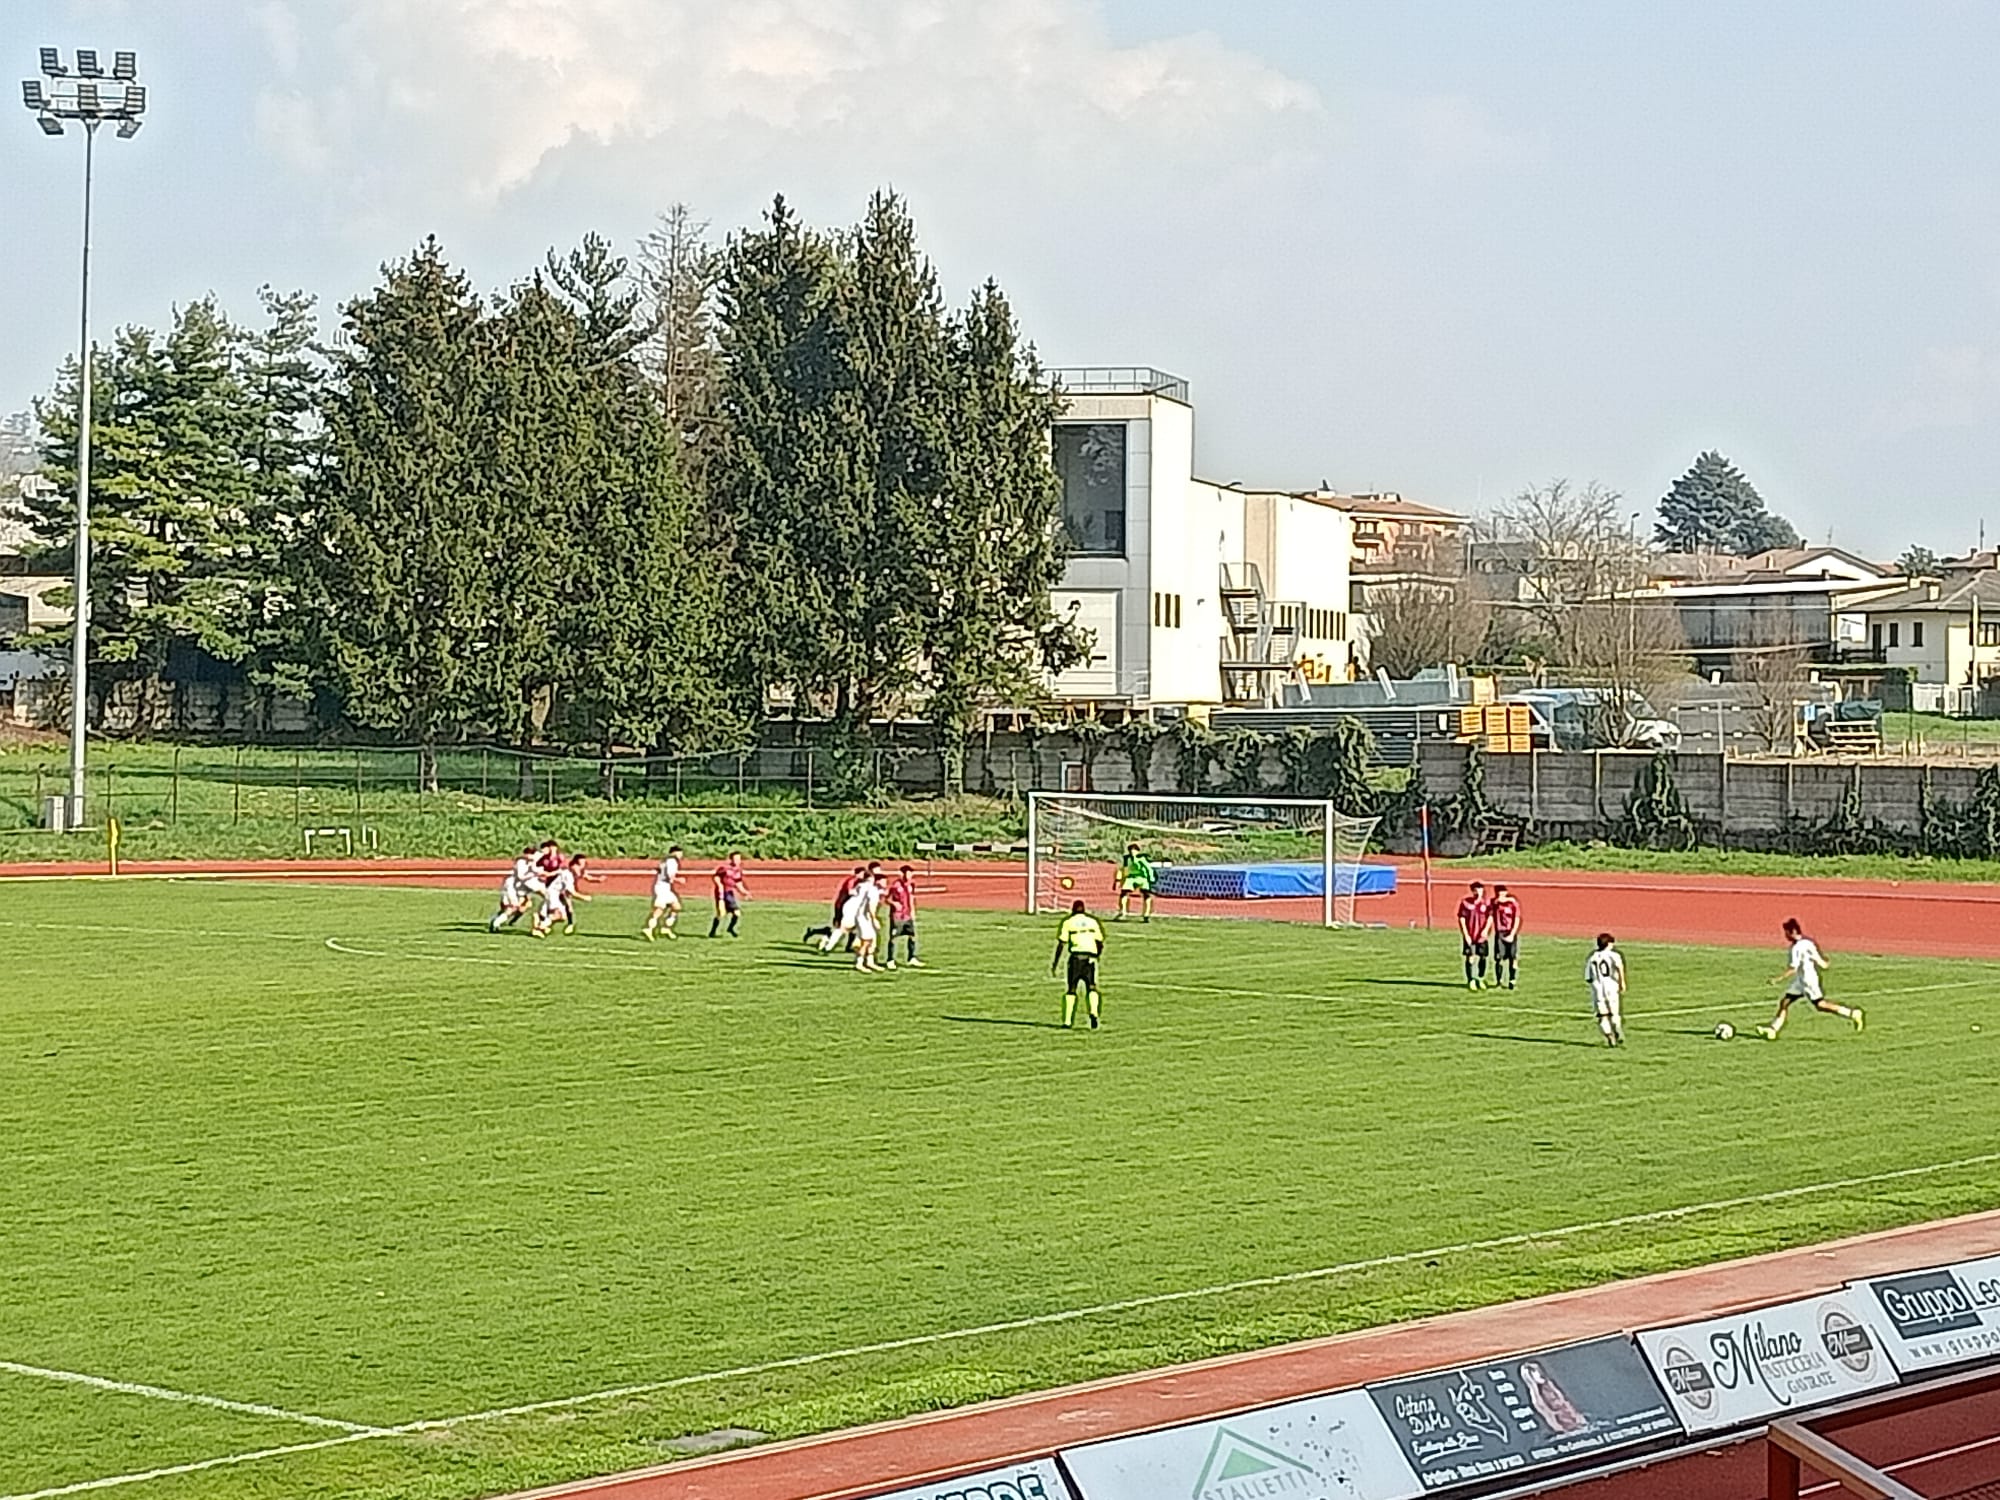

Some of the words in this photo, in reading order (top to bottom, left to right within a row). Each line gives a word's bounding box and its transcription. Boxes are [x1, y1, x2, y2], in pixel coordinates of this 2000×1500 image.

[1592, 959, 1610, 984] 10
[1883, 1287, 1967, 1323] Gruppo
[1710, 1321, 1802, 1405] Milano
[1203, 1470, 1307, 1500] STALLETTI
